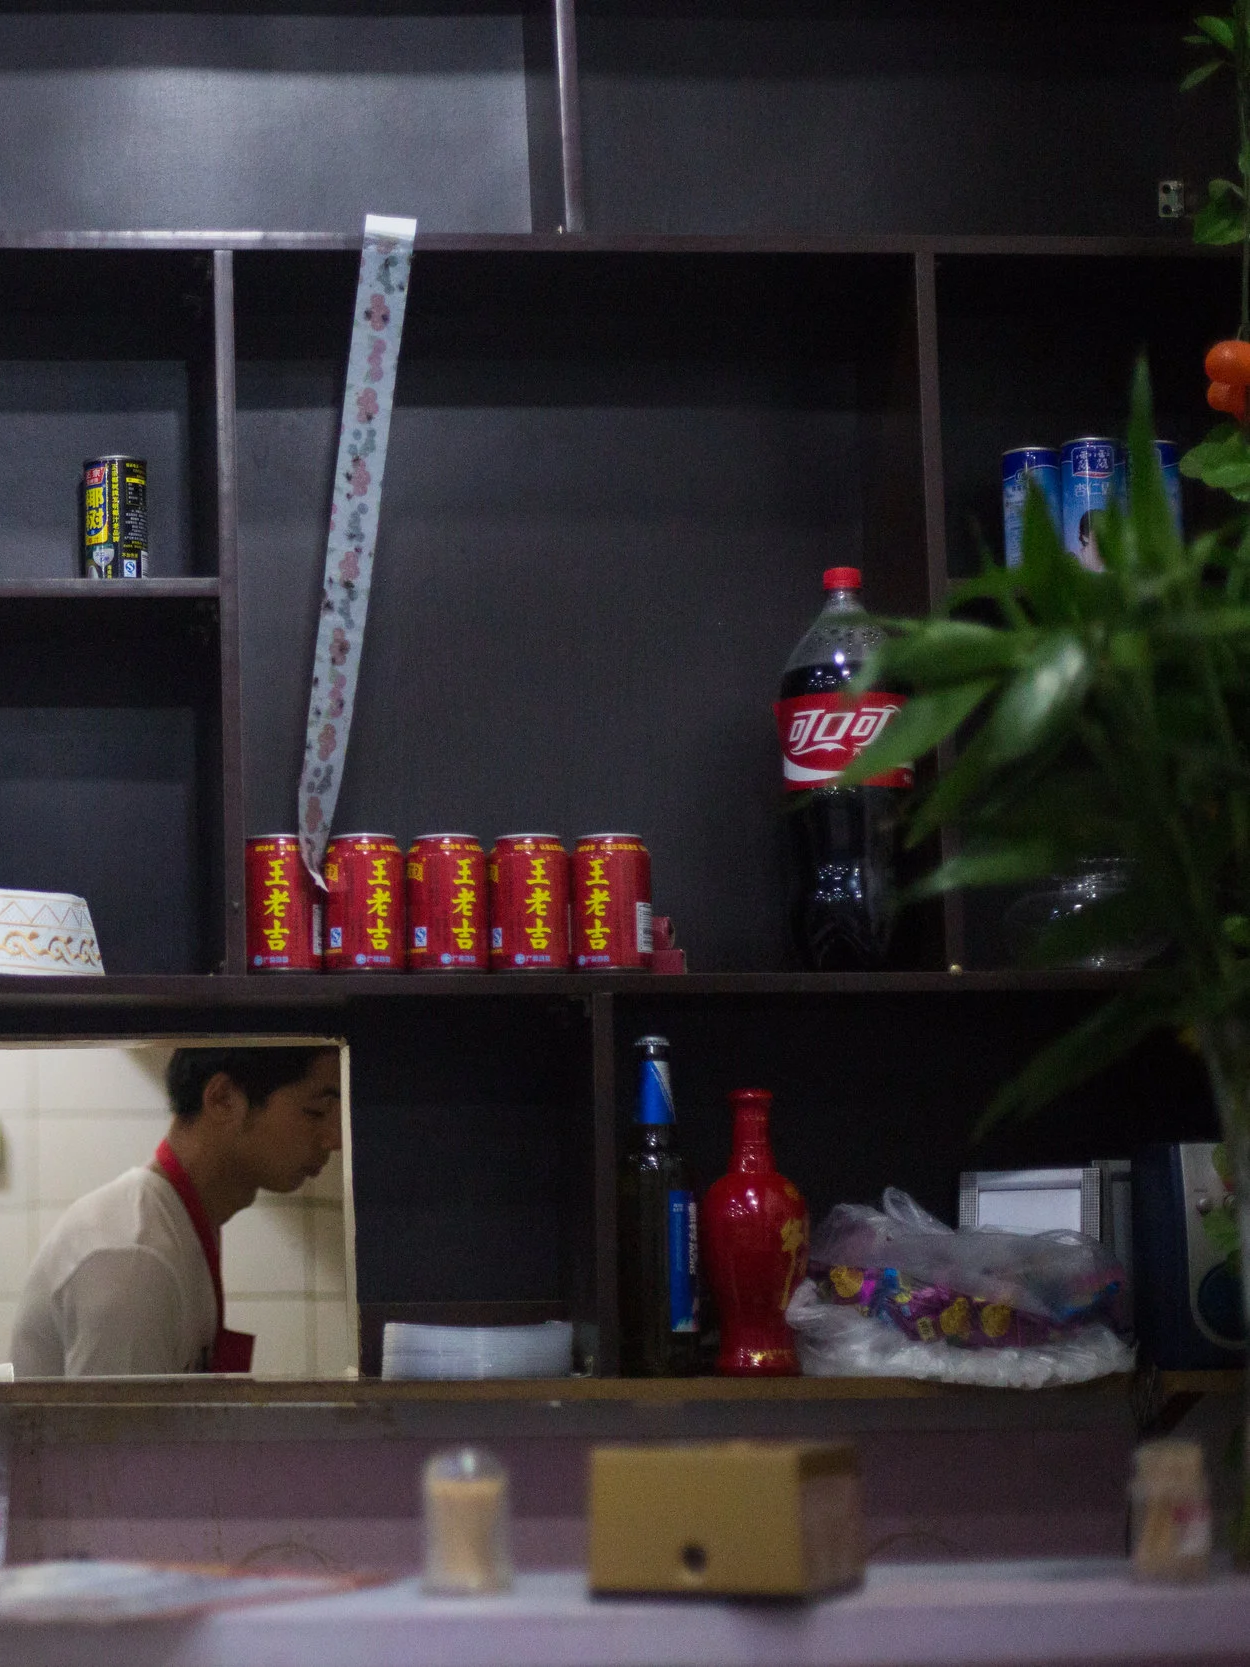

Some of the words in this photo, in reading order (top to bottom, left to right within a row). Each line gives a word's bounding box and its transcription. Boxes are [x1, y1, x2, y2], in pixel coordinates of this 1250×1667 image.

[789, 704, 901, 756] 可口可
[263, 858, 291, 951] 王老吉
[365, 858, 392, 951] 王老吉
[451, 858, 477, 950] 王老吉
[524, 858, 552, 950] 王老吉
[584, 858, 611, 950] 王老吉
